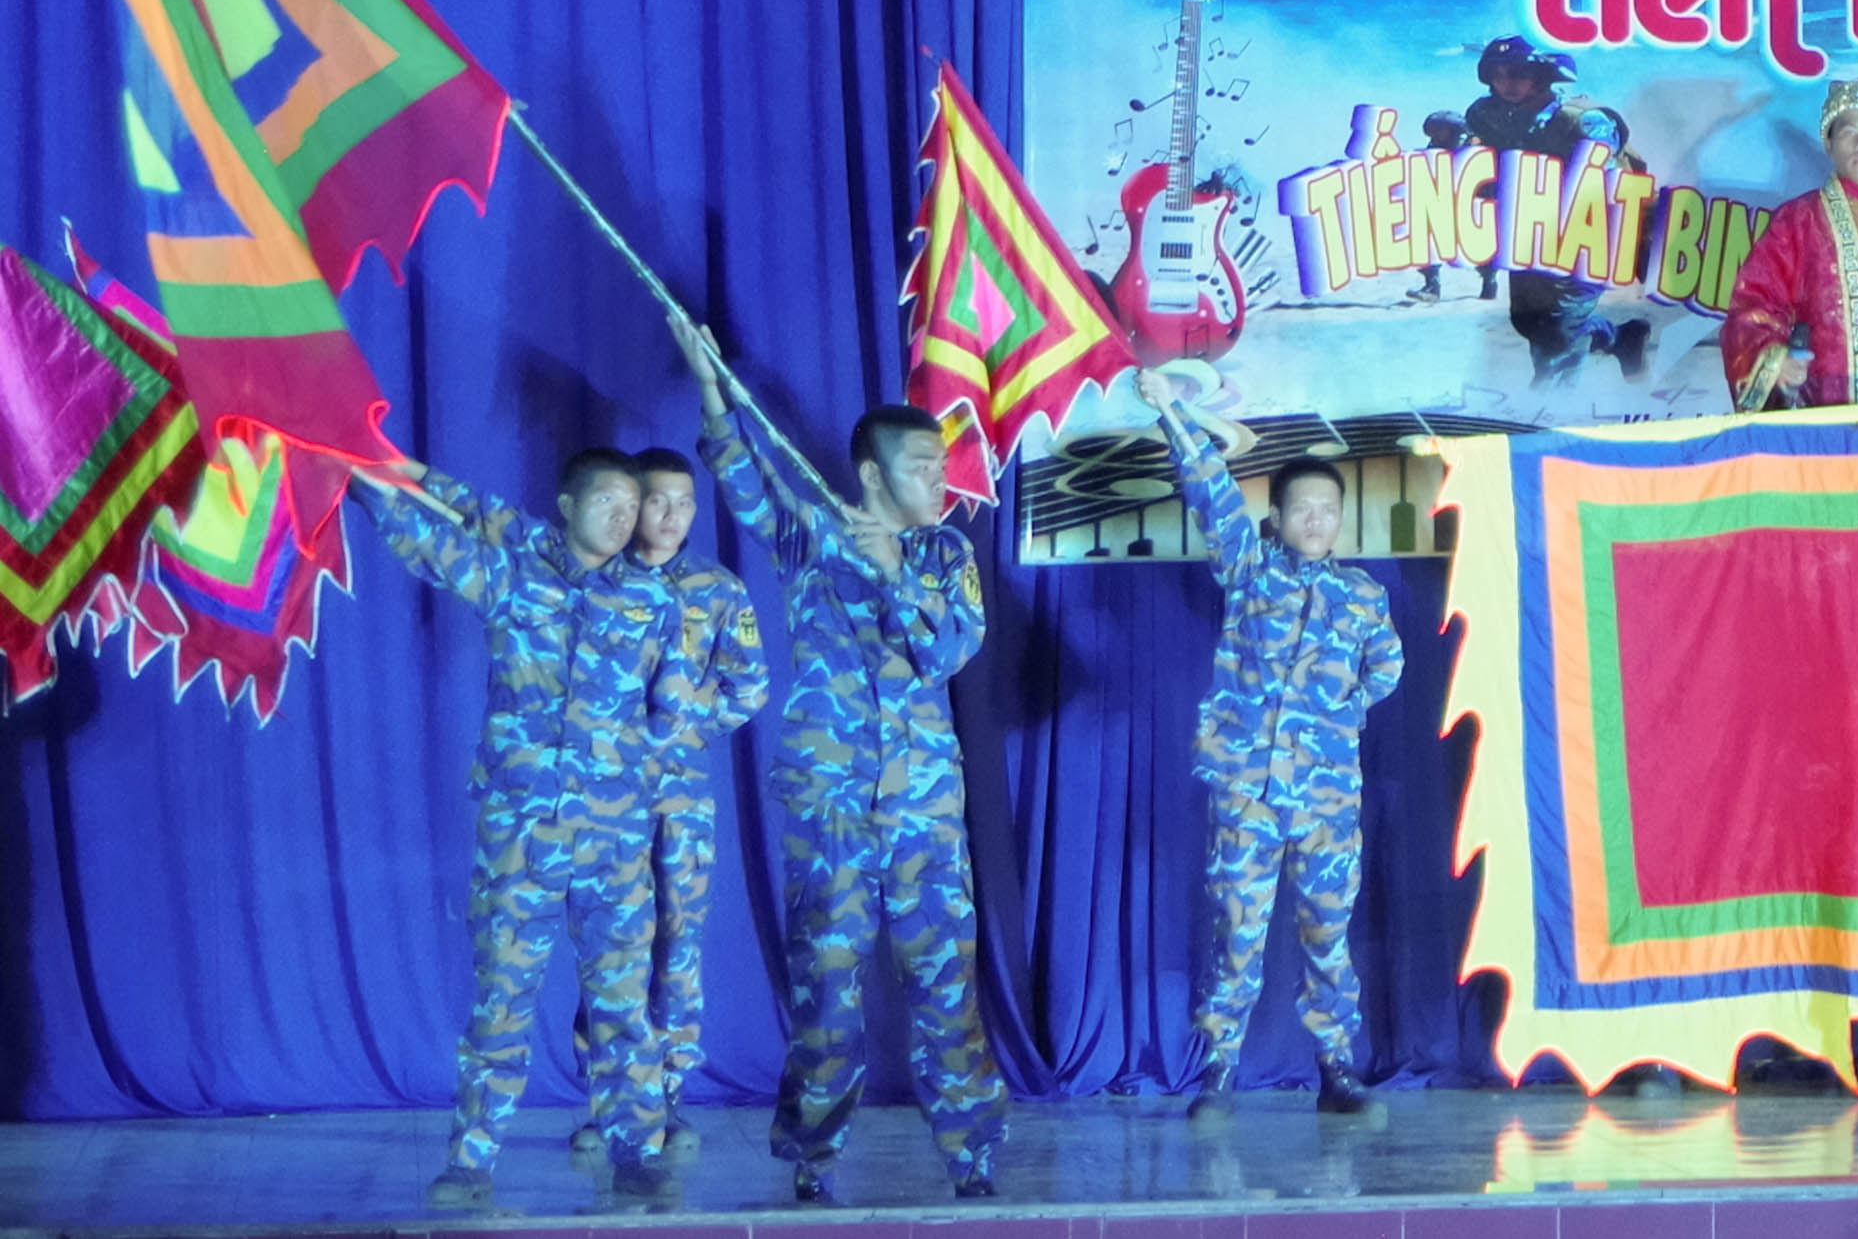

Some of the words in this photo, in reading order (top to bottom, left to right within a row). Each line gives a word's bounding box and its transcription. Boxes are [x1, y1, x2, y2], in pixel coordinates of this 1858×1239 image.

[1304, 106, 1499, 294] TIẾNG
[1511, 142, 1656, 287] HÁT
[1656, 184, 1773, 314] BIN
